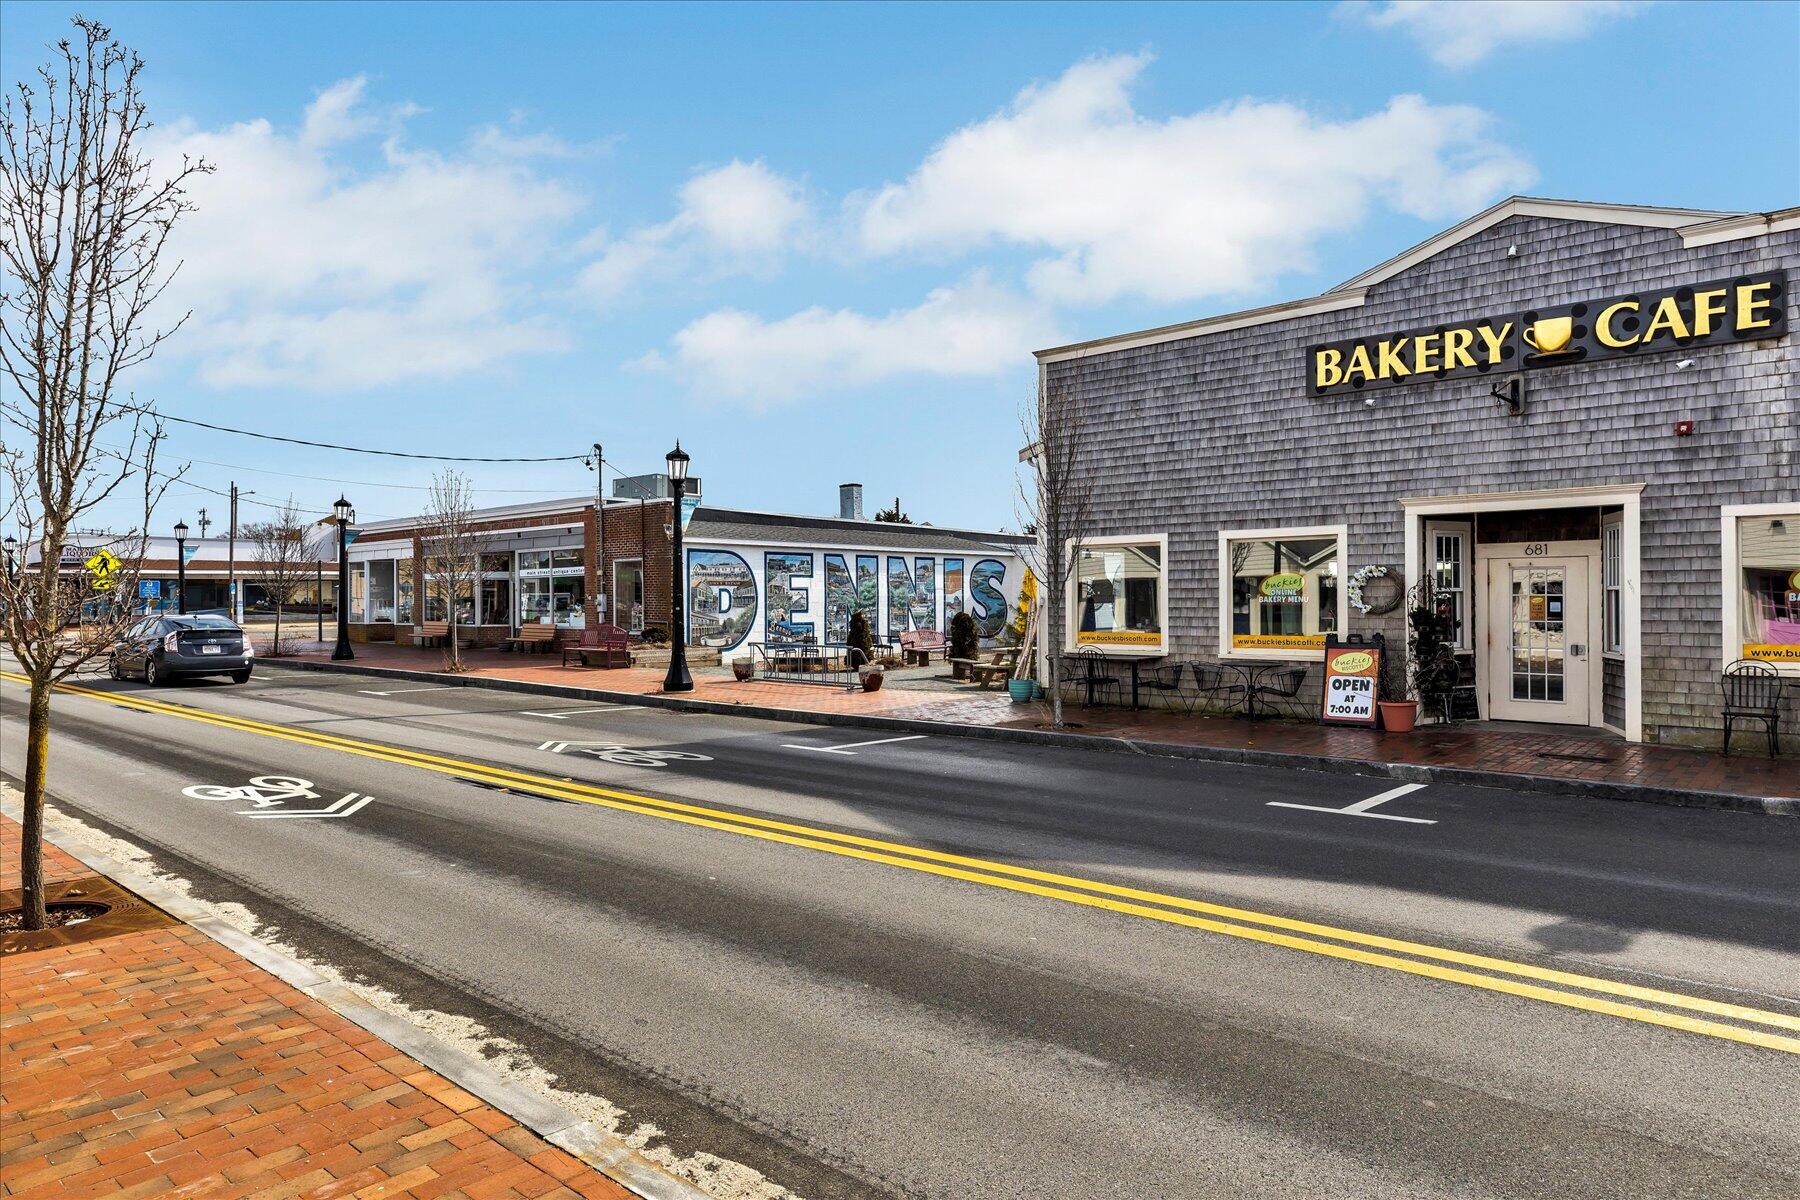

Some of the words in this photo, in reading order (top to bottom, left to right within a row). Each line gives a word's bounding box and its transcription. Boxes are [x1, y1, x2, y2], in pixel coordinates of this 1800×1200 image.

[1315, 321, 1514, 388] BAKERY
[1595, 282, 1772, 348] CAFE
[1525, 543, 1548, 556] 681
[1264, 577, 1302, 589] buckies
[686, 548, 1008, 652] DENNIS
[1334, 656, 1370, 666] buckies
[1341, 664, 1364, 672] BISCOTTI
[1332, 679, 1370, 692] OPEN
[1330, 705, 1351, 714] 7:00
[1353, 706, 1369, 715] AM
